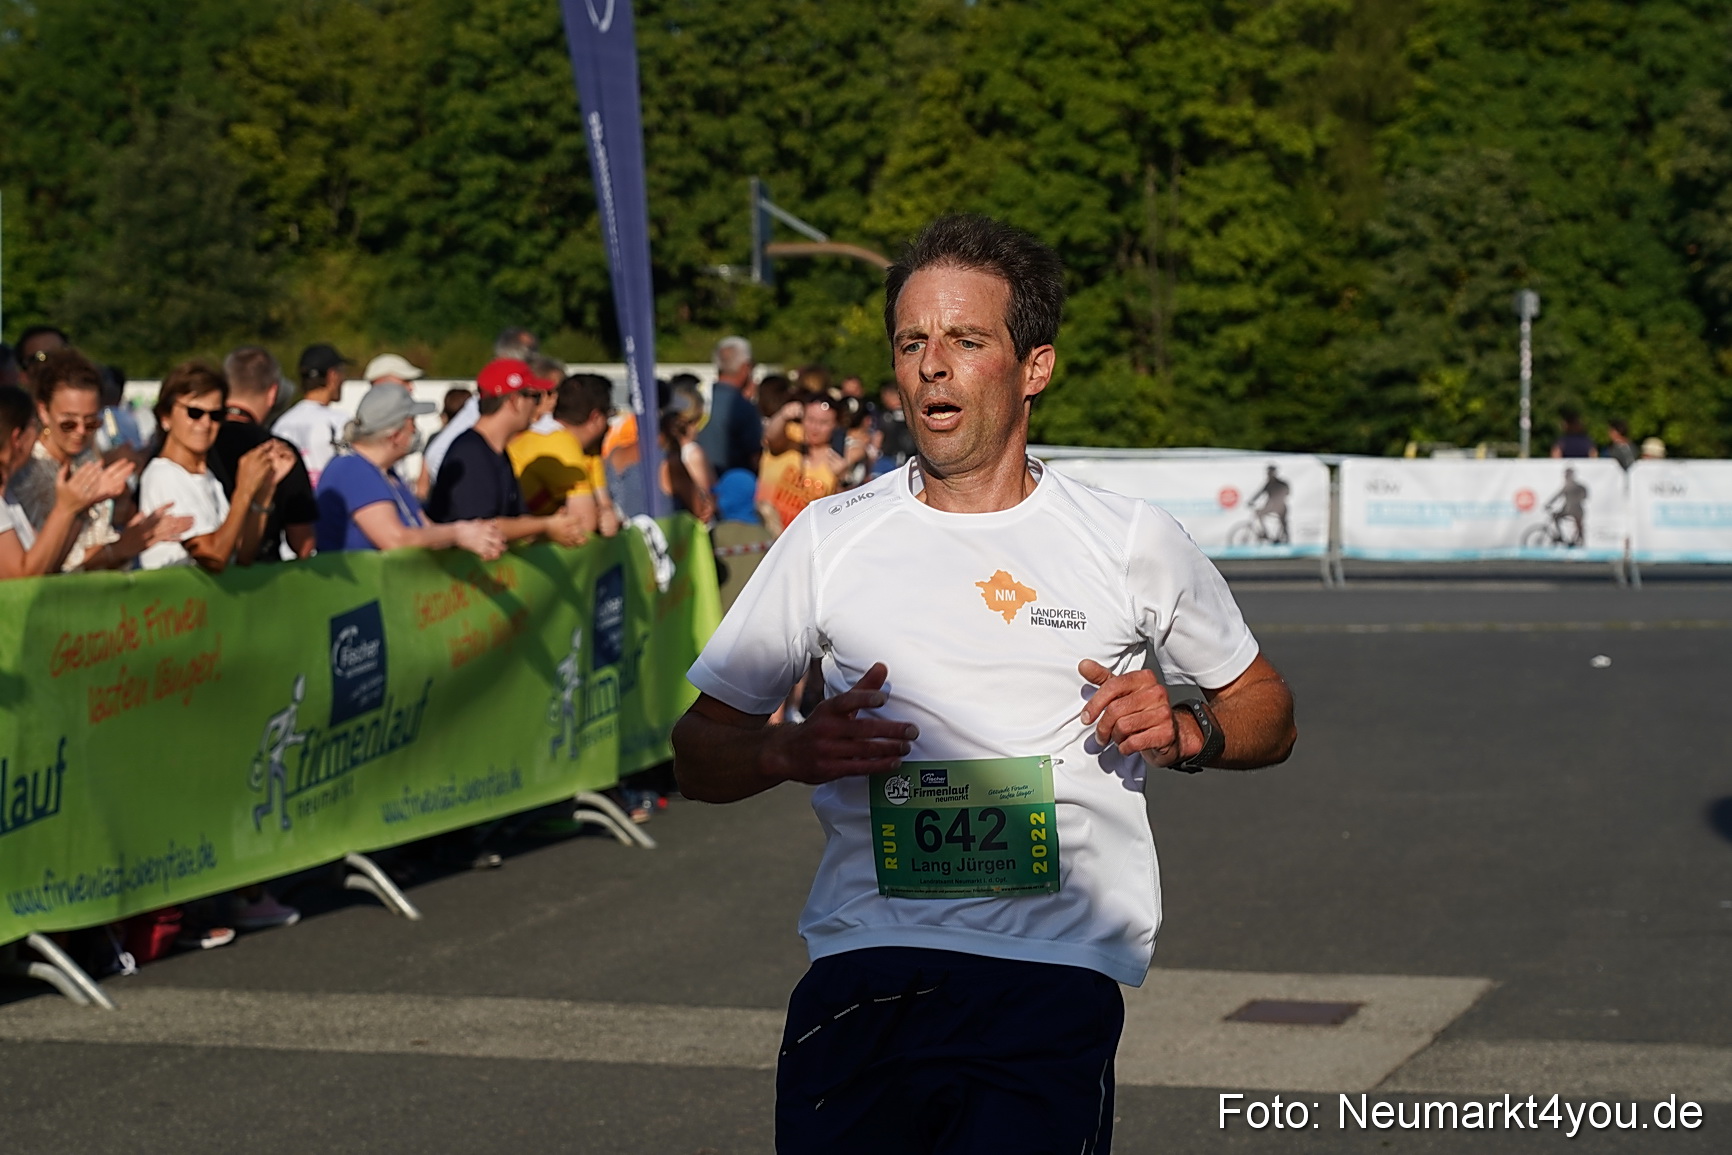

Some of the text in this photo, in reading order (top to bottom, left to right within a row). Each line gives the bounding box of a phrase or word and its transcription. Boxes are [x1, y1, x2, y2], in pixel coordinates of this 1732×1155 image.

[845, 492, 875, 508] JAKO
[995, 590, 1016, 602] NM
[1030, 606, 1086, 620] LANDKREIS
[1030, 616, 1087, 630] NEUMARKT
[914, 784, 969, 798] Firmenlauf
[935, 794, 969, 803] neumarkt
[914, 808, 1008, 853] 642
[882, 824, 898, 869] RUN
[1030, 812, 1048, 874] 2022
[912, 857, 1016, 876] Lang Jürgen
